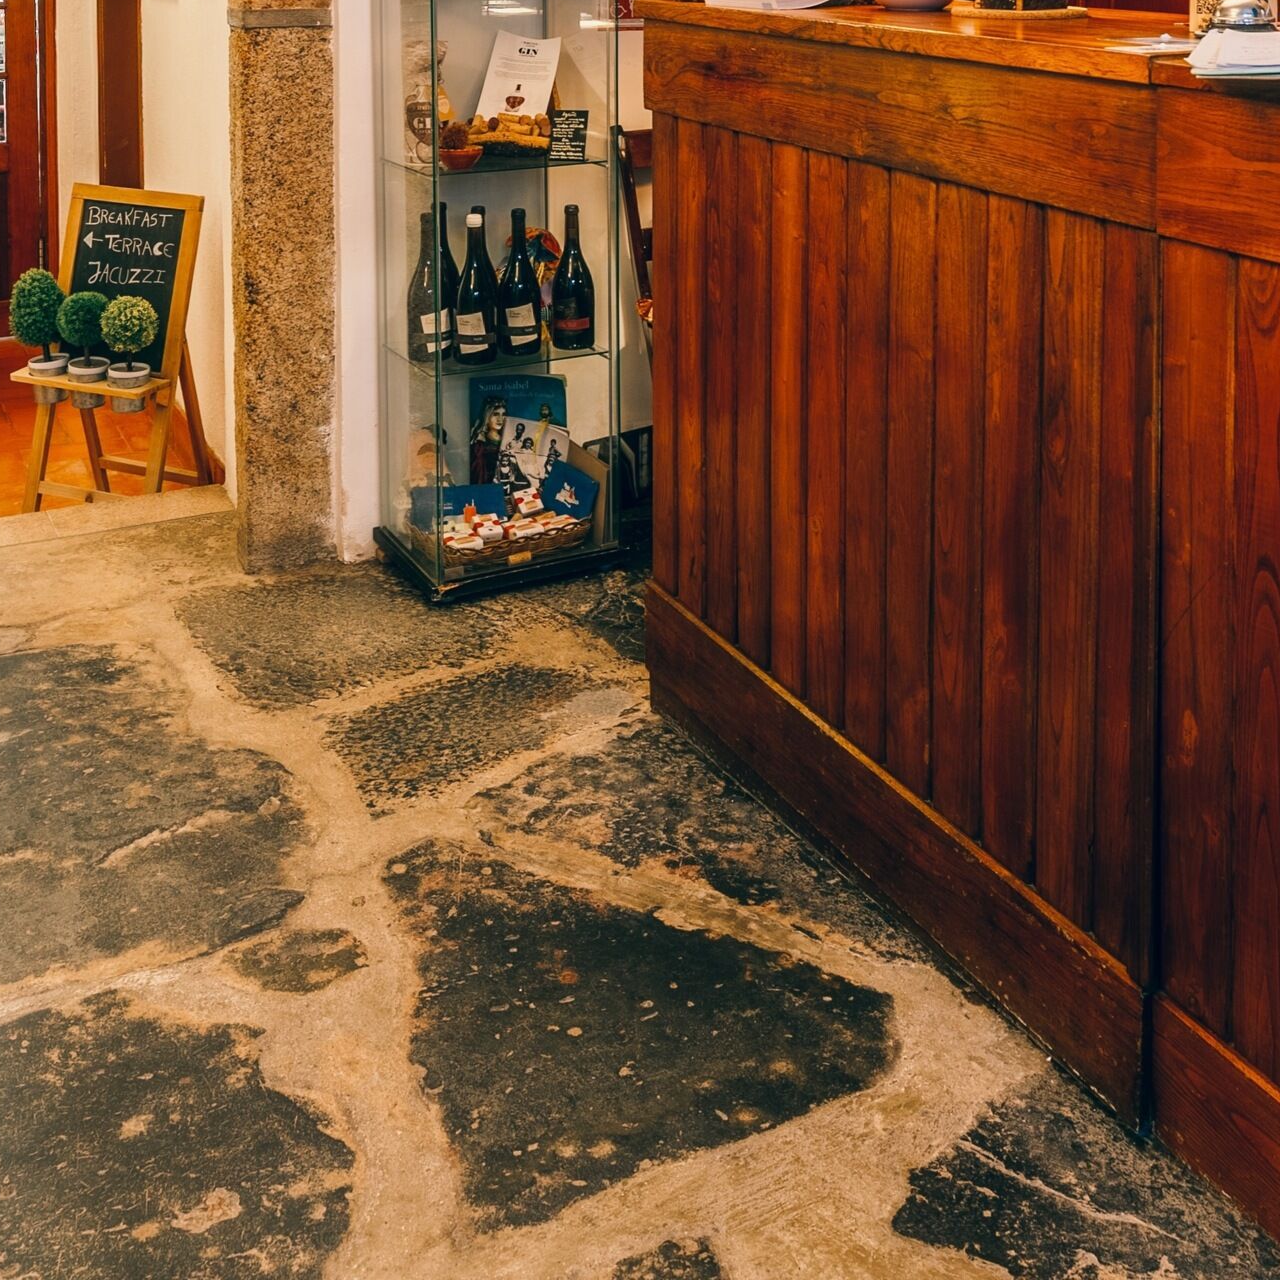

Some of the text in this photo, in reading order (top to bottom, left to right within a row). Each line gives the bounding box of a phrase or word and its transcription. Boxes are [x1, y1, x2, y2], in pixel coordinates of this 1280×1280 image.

[518, 47, 539, 55] GIN
[85, 205, 173, 228] BREAKFAST
[104, 234, 175, 258] TERRACE
[88, 261, 166, 285] JACUZZI
[478, 380, 529, 391] Santa Isabel
